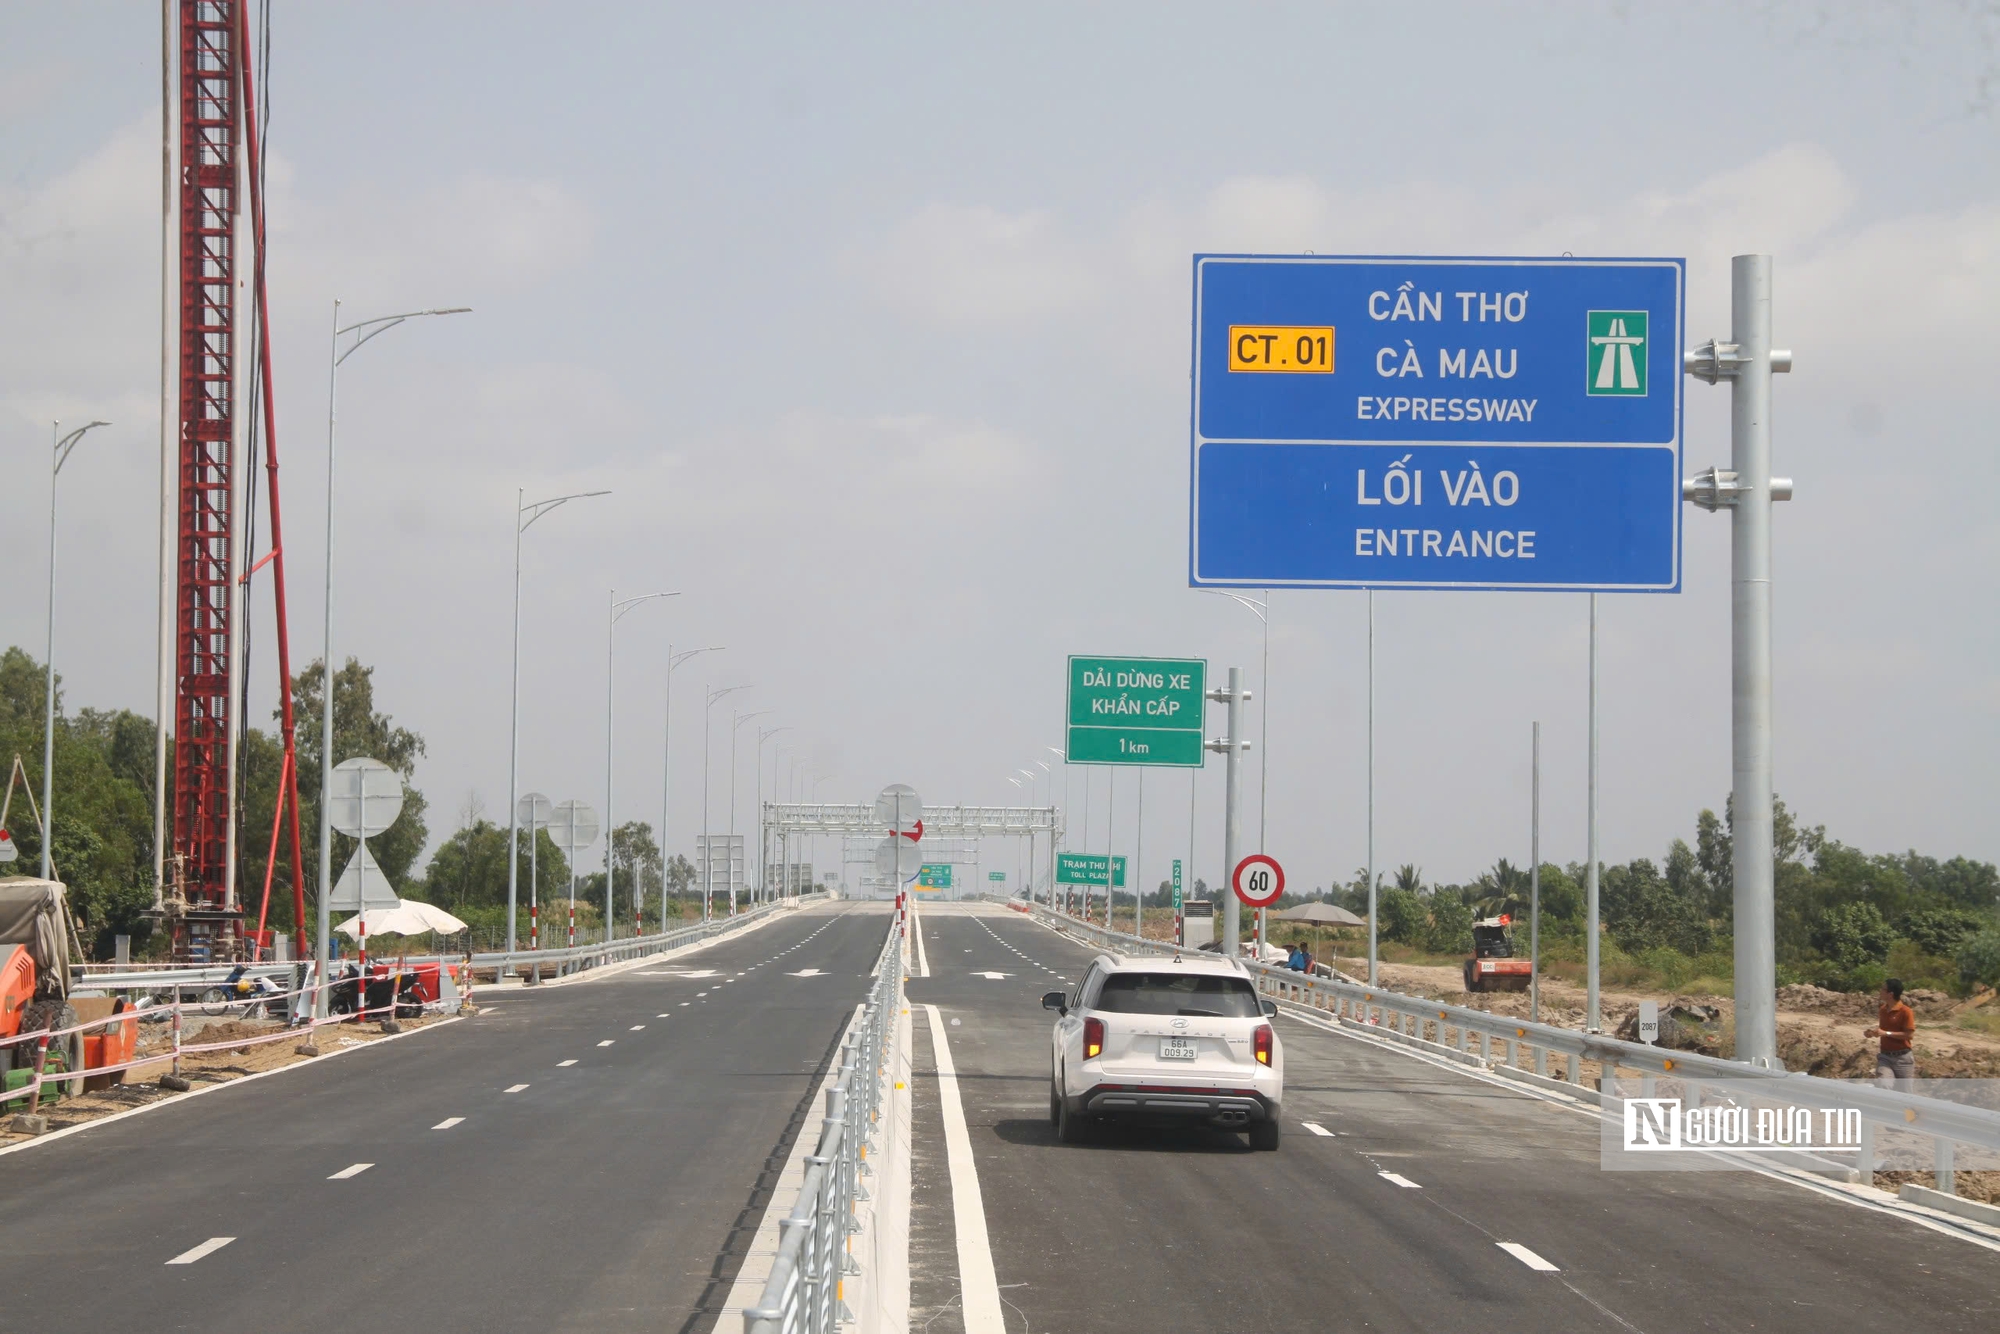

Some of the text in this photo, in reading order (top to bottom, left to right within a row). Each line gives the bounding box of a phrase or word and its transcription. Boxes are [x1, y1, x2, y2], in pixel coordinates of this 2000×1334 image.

[1368, 281, 1529, 322] CẦN THƠ
[1376, 340, 1517, 379] CÀ MAU
[1357, 396, 1538, 422] EXPRESSWAY
[1358, 454, 1519, 507] LỐI VÀO
[1355, 529, 1536, 558] ENTRANCE
[1083, 667, 1190, 689] DẢI DỪNG XE
[1092, 693, 1180, 715] KHẨN CẤP
[1119, 738, 1149, 753] 1 km
[1063, 860, 1087, 869] TRẠM
[1249, 872, 1269, 891] 60
[1164, 1048, 1194, 1057] 009.29
[1171, 1040, 1187, 1048] 66A
